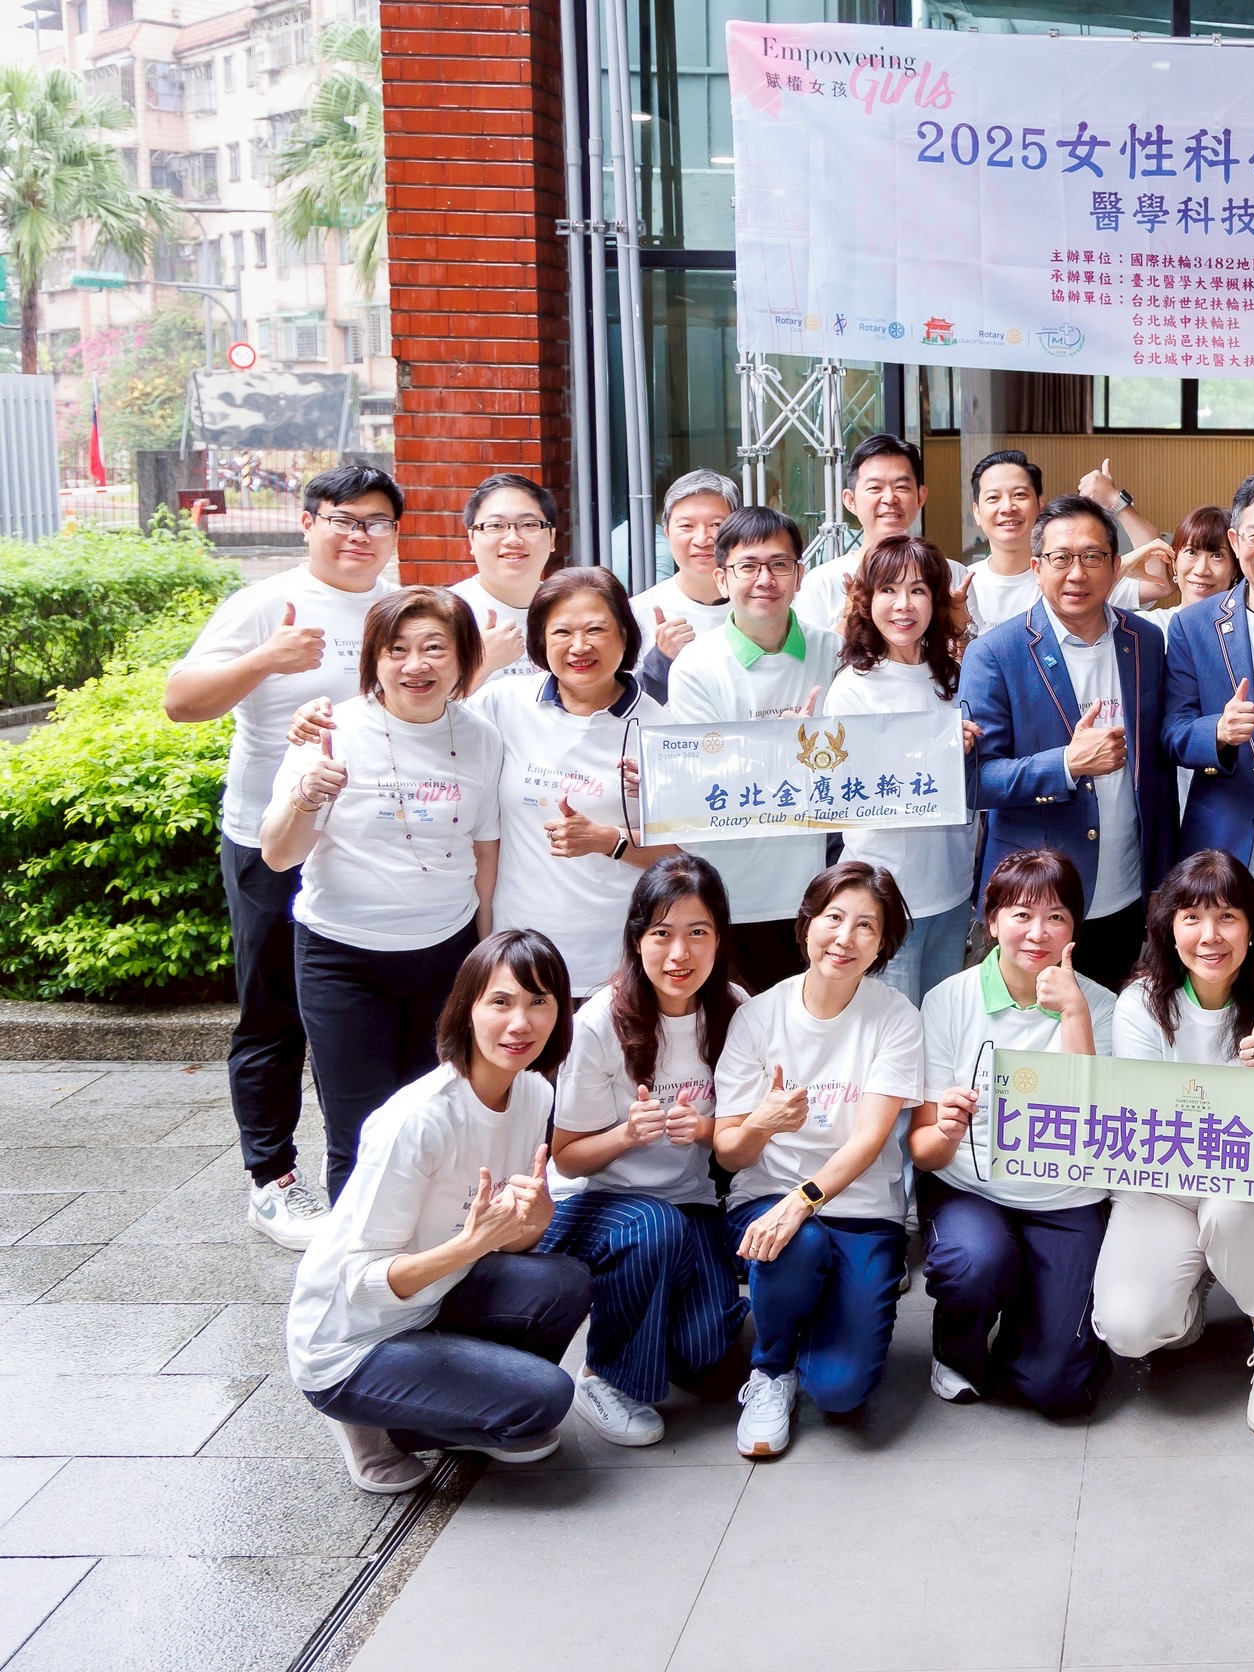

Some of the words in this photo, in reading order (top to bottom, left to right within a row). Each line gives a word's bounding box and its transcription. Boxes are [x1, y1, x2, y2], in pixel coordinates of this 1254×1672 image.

[762, 36, 917, 77] Empowering
[765, 72, 848, 98] 賦權女孩
[850, 59, 957, 115] Girls
[775, 316, 802, 327] Rotary
[858, 323, 886, 334] Rotary
[1132, 313, 1240, 330] 台北城中扶輪社
[978, 330, 1004, 340] Rotary
[1132, 332, 1241, 348] 台北尚邑扶輪社
[662, 740, 699, 750] Rotary
[682, 751, 699, 759] 3482
[527, 763, 590, 784] Empowering
[415, 783, 462, 806] Girls
[560, 777, 605, 797] Girls
[705, 772, 939, 812] 台北金鷹扶輪社
[710, 815, 752, 828] Rotary
[759, 811, 787, 824] Club
[794, 809, 808, 822] of
[814, 806, 849, 821] Taipei
[856, 803, 899, 818] Golden
[905, 801, 938, 817] Eagle
[660, 1096, 675, 1104] 女孩
[1005, 1158, 1060, 1179] CLUB
[1067, 1163, 1094, 1182] OF
[1103, 1167, 1169, 1189] TAIPEI
[1179, 1172, 1234, 1195] WEST
